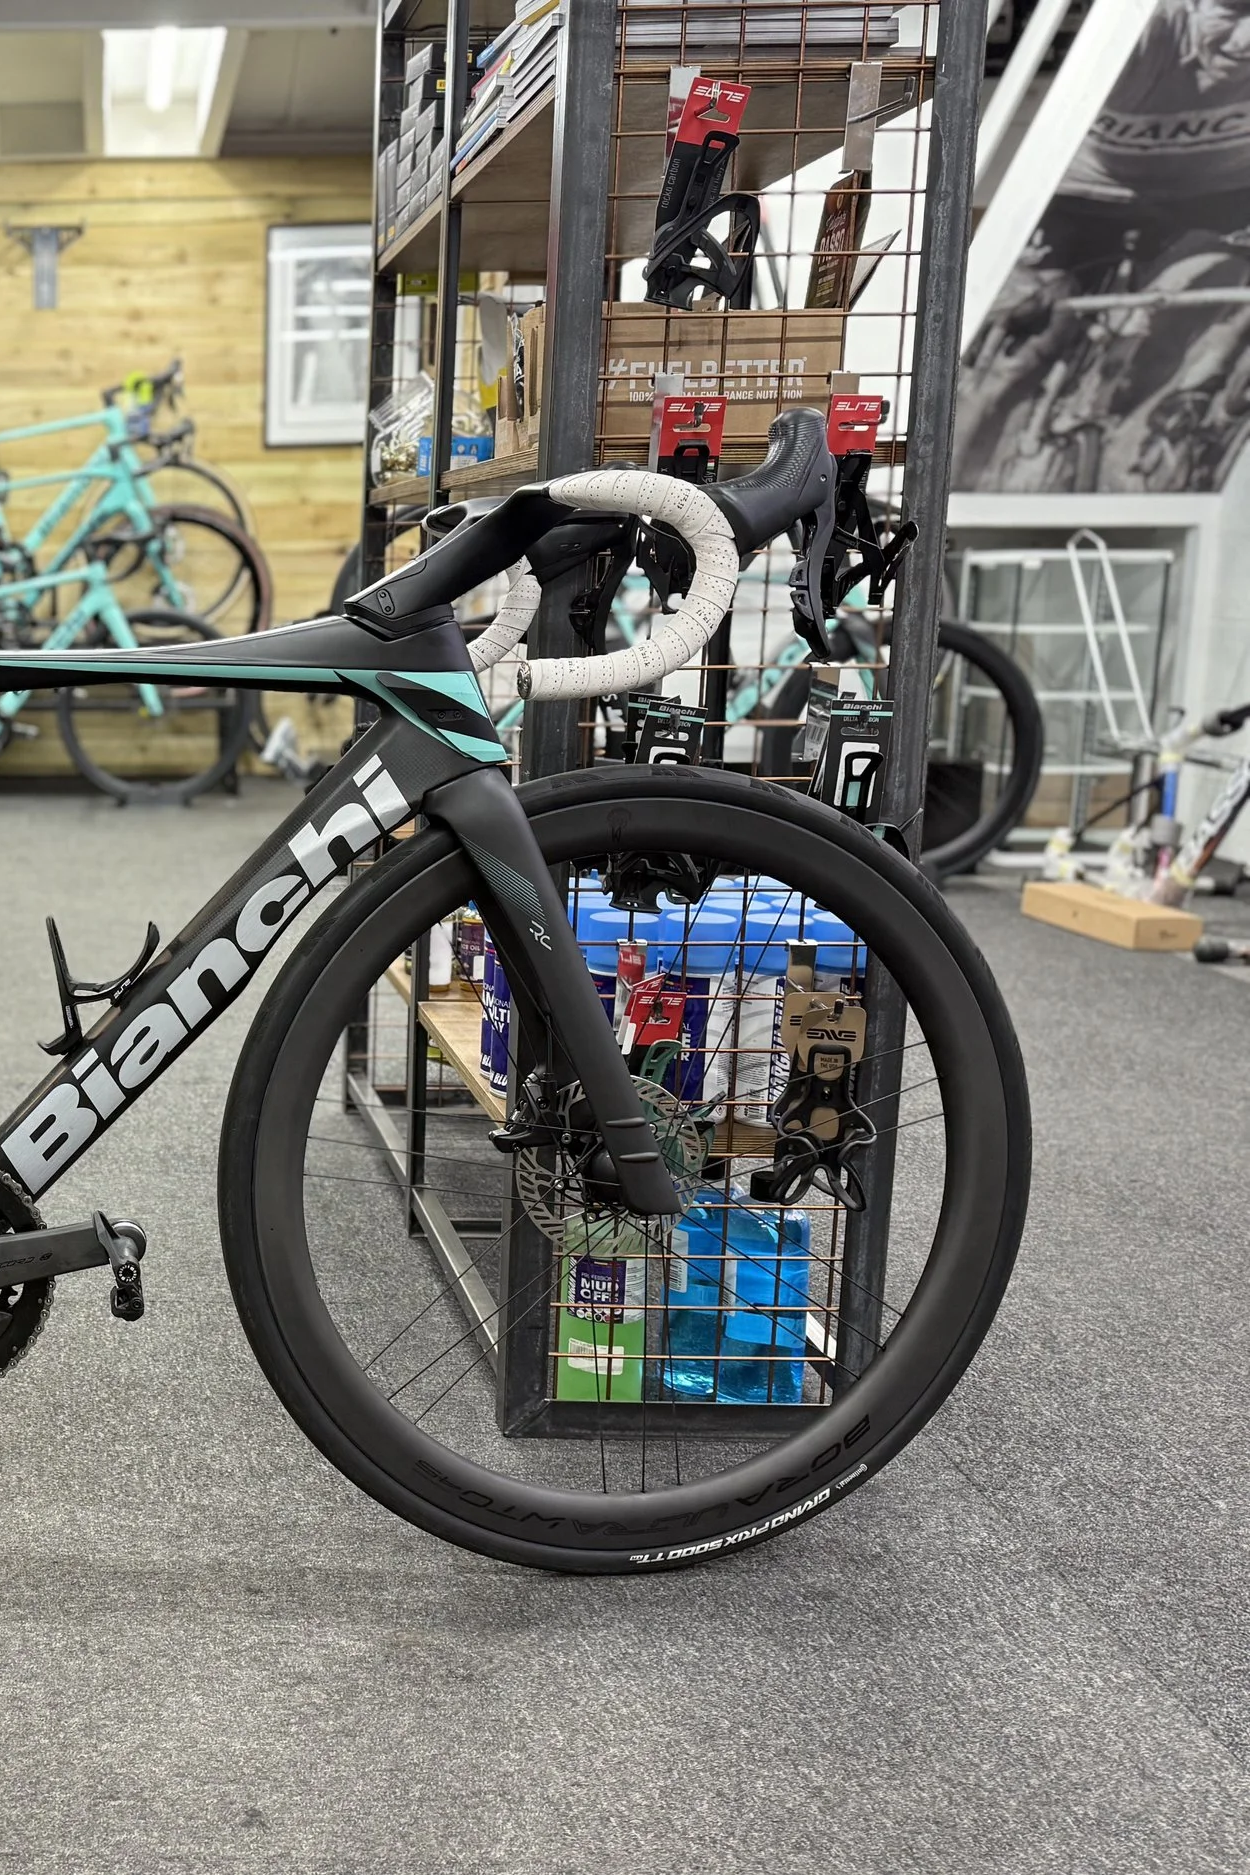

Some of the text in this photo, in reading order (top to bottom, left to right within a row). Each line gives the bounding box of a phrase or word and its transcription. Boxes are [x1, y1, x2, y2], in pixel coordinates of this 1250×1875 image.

[661, 157, 682, 209] rocko carbon
[756, 389, 803, 400] NUTRTION
[835, 401, 881, 412] ELITE
[658, 704, 697, 716] Bianchi
[842, 703, 883, 711] Bianchi
[529, 920, 552, 951] RC
[0, 753, 412, 1196] Bianchi
[580, 1277, 619, 1292] MUD
[734, 1413, 871, 1506] BORA
[770, 1487, 832, 1530] GRAND
[723, 1521, 772, 1548] PRIX
[665, 1537, 724, 1561] 5000
